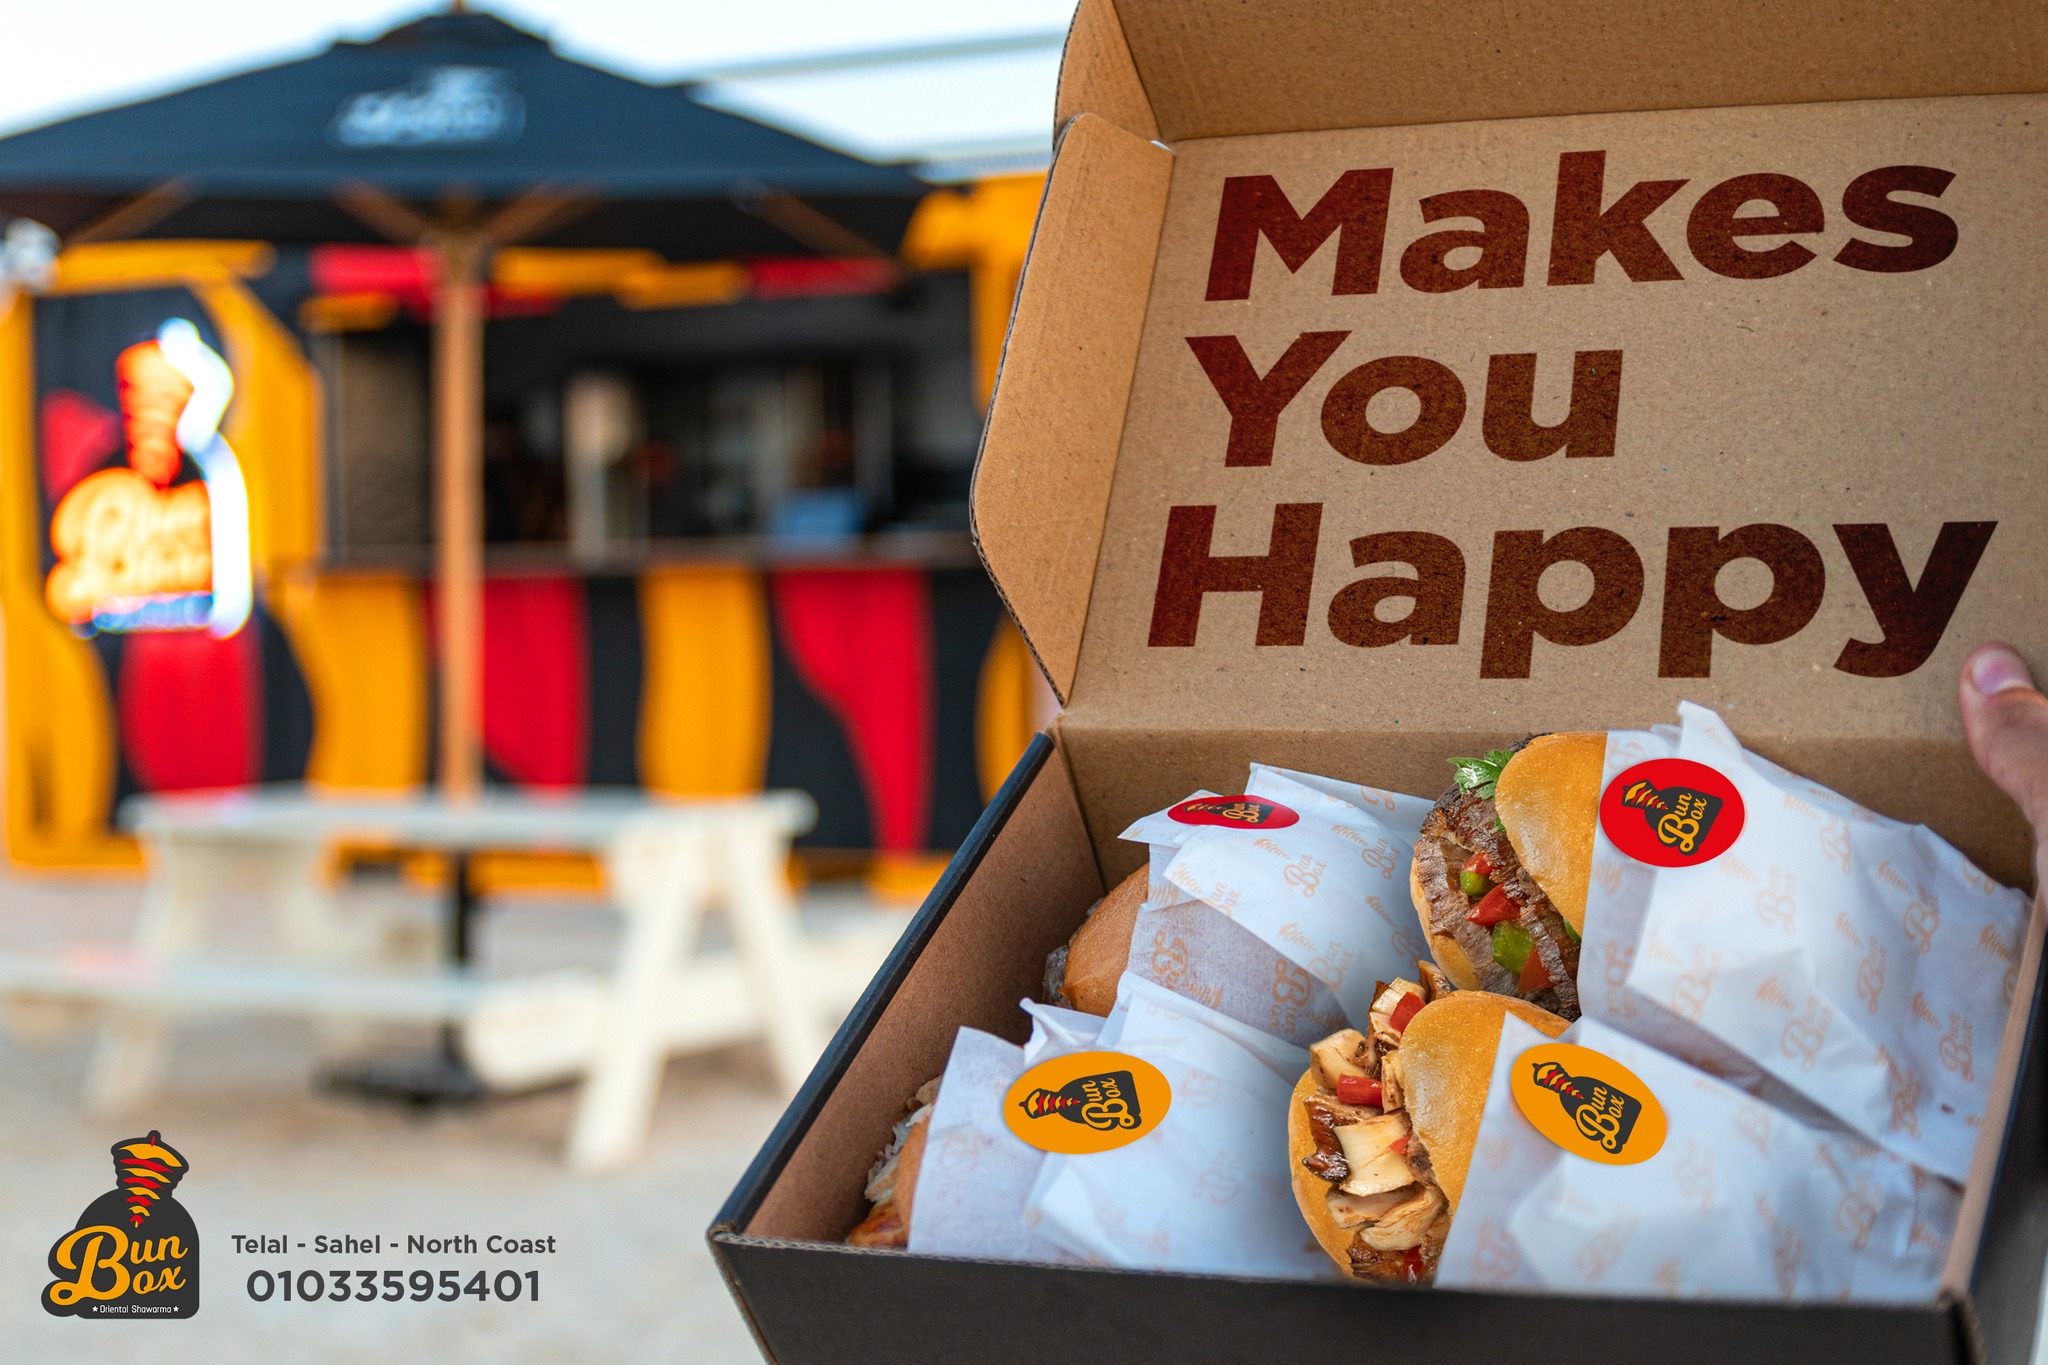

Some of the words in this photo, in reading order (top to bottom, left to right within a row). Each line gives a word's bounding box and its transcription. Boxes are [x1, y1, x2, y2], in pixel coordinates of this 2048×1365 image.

[1204, 150, 1959, 302] Makes
[1184, 330, 1623, 468] You
[1147, 502, 1999, 680] Happy
[1658, 793, 1692, 844] Bun
[1678, 798, 1707, 852] Box
[1081, 1080, 1111, 1128] Bun
[1101, 1078, 1135, 1127] Box
[1576, 1087, 1607, 1138] Bun
[1596, 1095, 1625, 1149] Box
